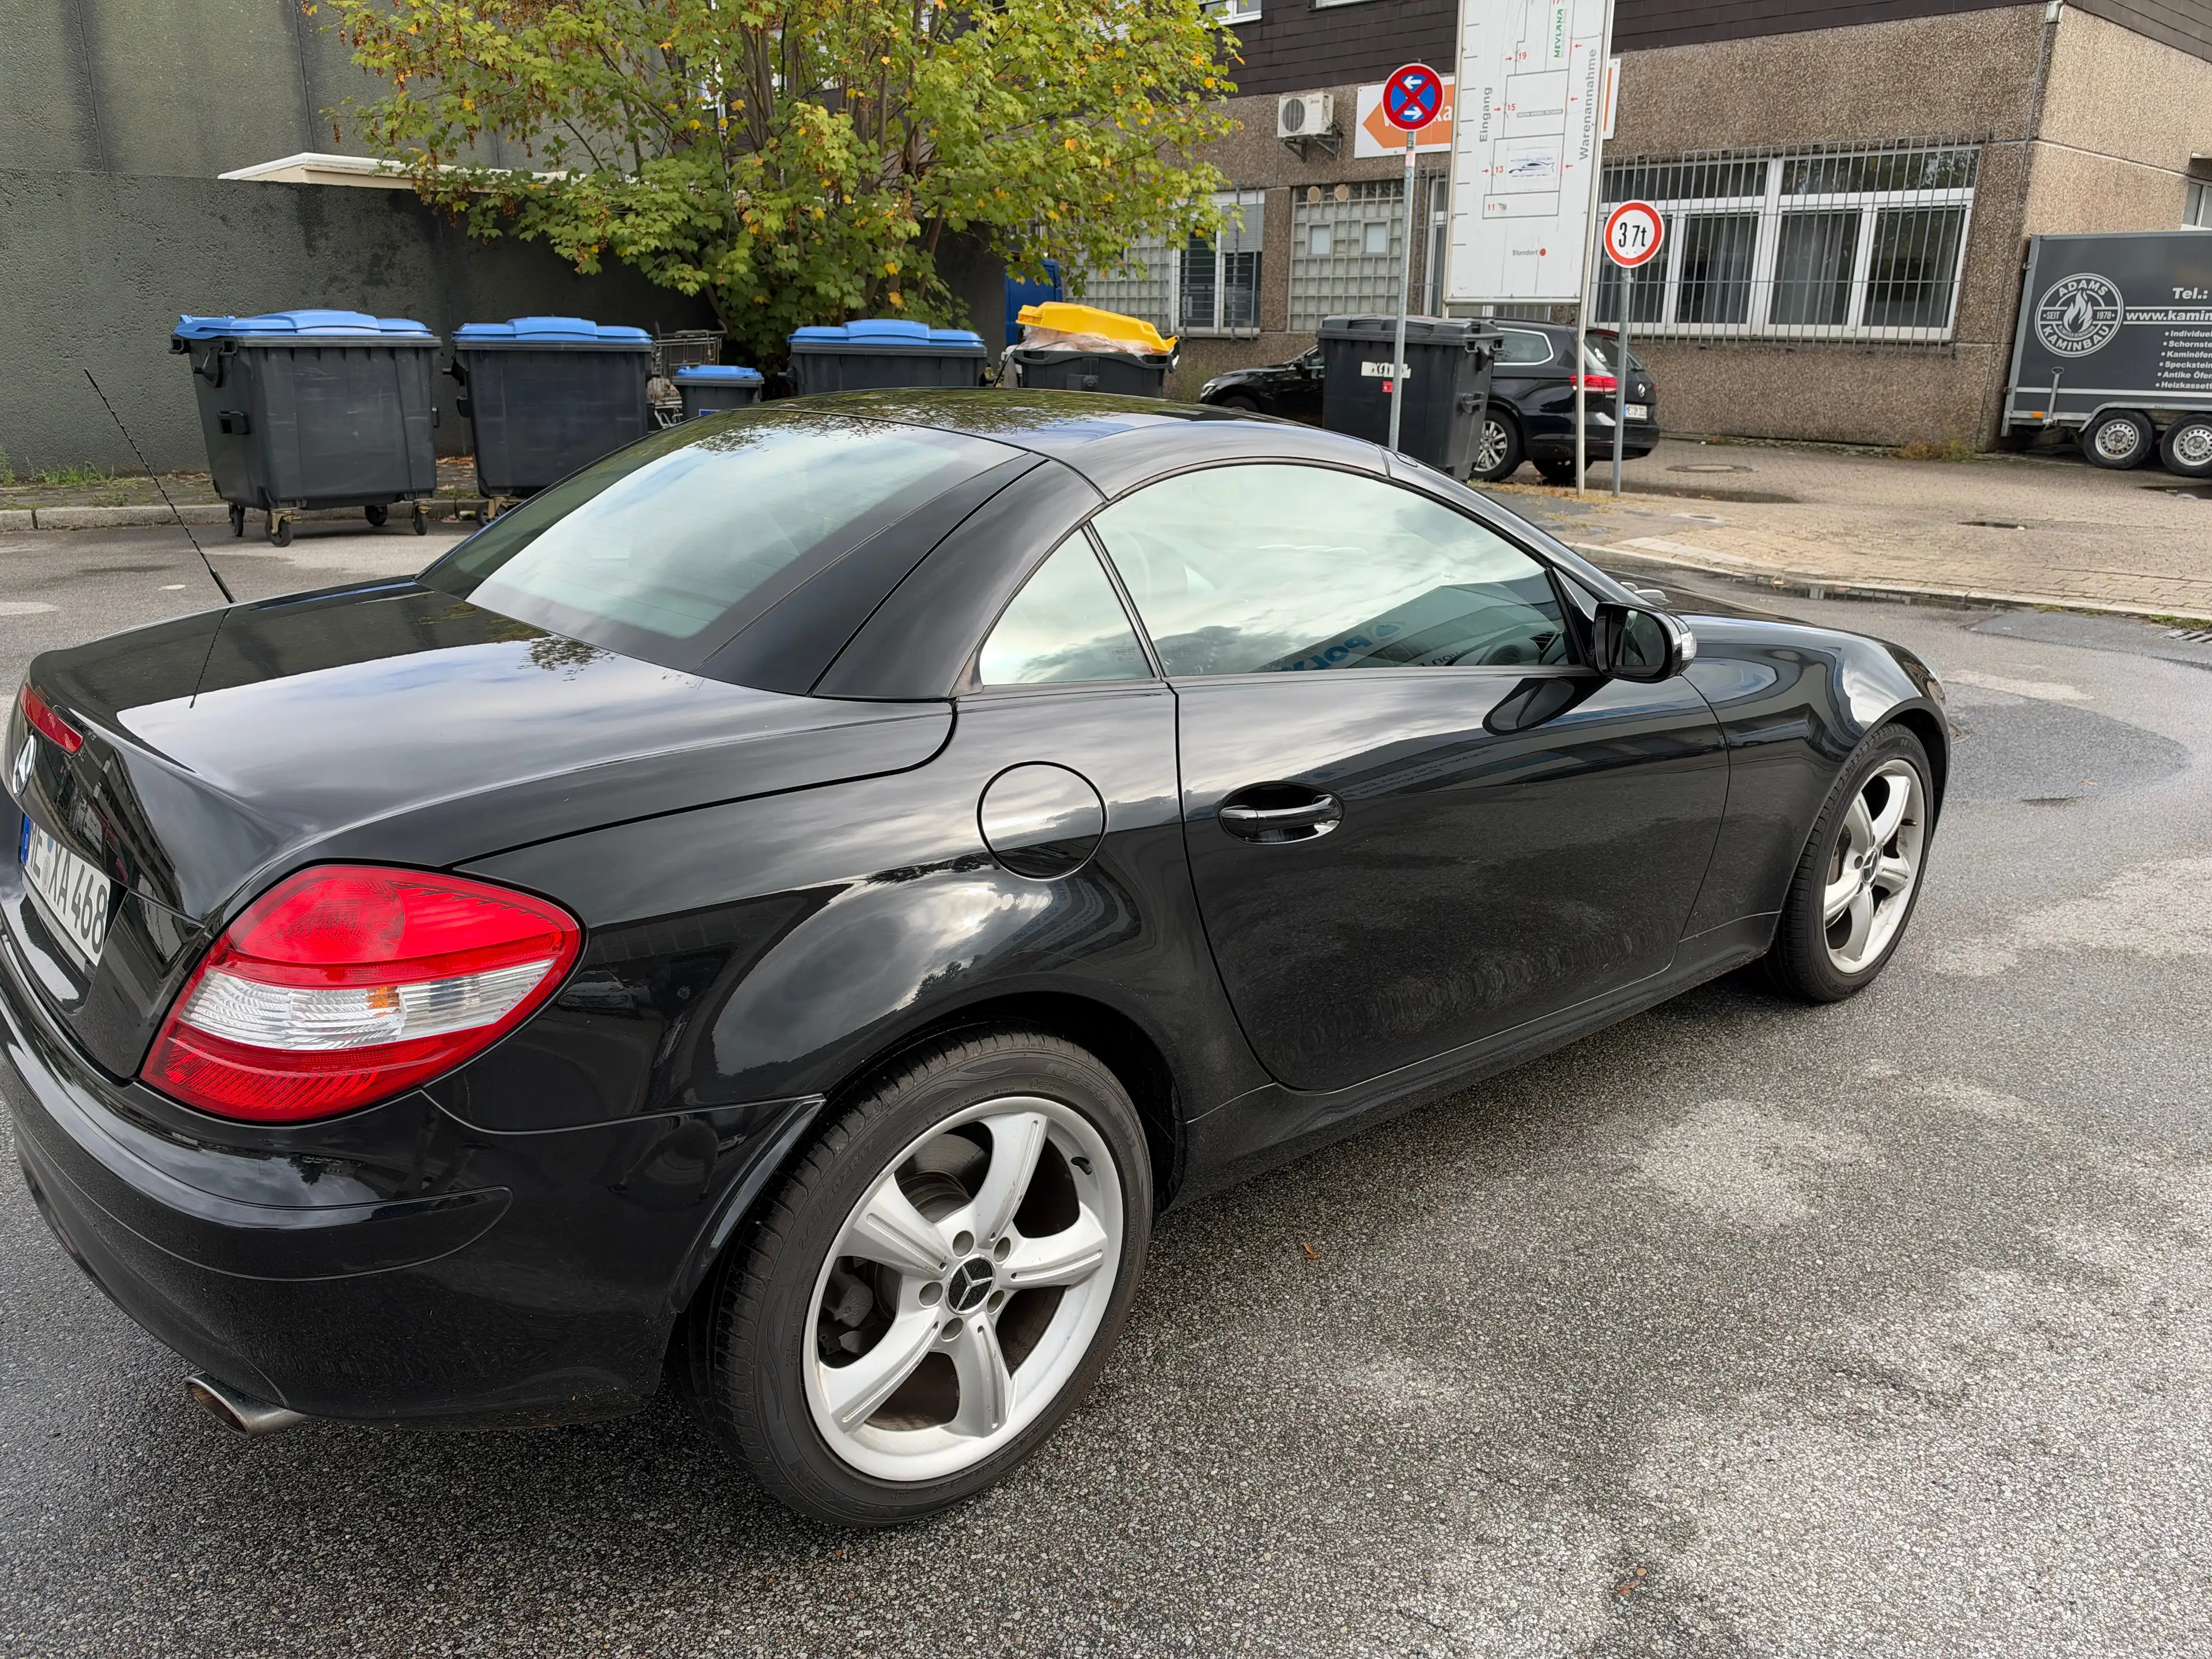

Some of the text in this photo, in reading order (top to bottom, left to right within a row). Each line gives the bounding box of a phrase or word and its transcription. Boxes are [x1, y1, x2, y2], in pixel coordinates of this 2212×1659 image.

[1554, 9, 1563, 58] MEVLANA
[1479, 87, 1493, 142] Eingang
[1579, 48, 1597, 160] Warenannahme
[2059, 279, 2108, 297] ADAMS
[2172, 287, 2209, 300] Tel.:
[2046, 310, 2112, 320] SEIT 1978
[2043, 324, 2109, 351] KAMINBAU
[48, 843, 71, 915] XA
[71, 864, 108, 955] 468
